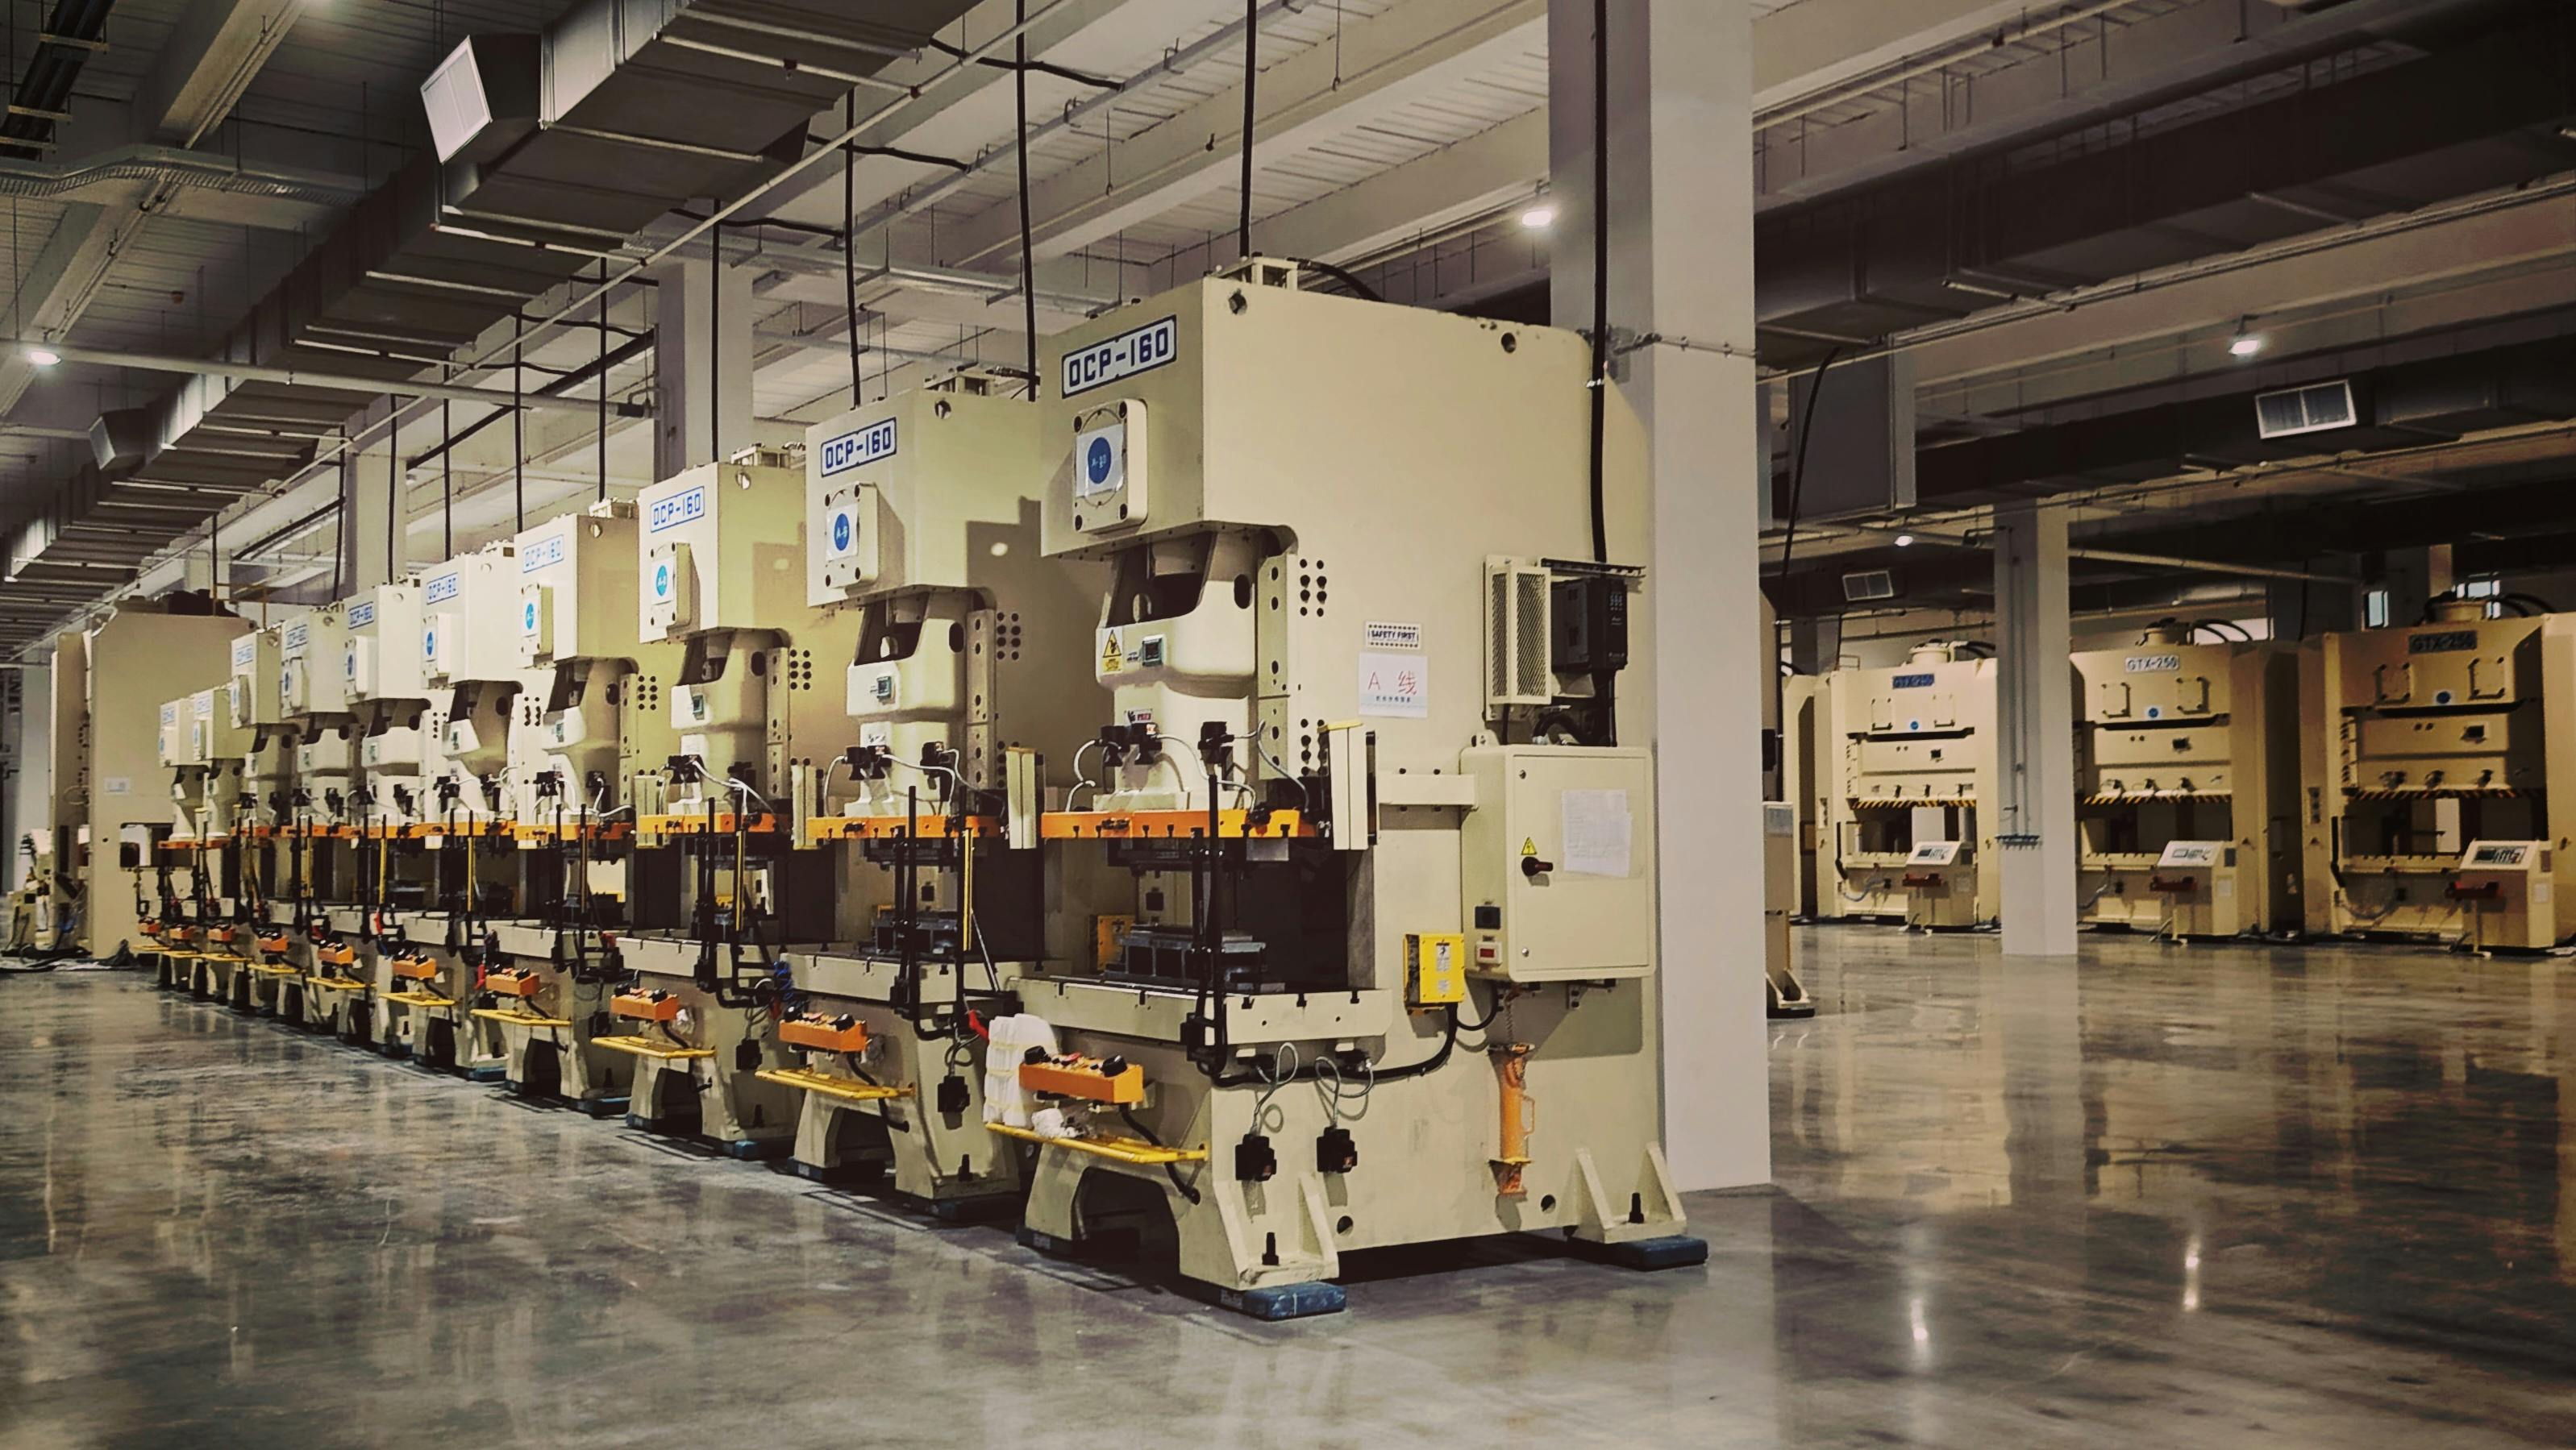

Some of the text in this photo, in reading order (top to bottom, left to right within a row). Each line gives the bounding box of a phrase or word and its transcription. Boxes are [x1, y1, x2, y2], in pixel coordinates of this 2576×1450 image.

[1069, 327, 1168, 387] OCP-160
[826, 426, 891, 468] OCP-160
[653, 493, 701, 526] OCP-160
[1371, 630, 1396, 638] SAFETY
[1367, 671, 1380, 691] A
